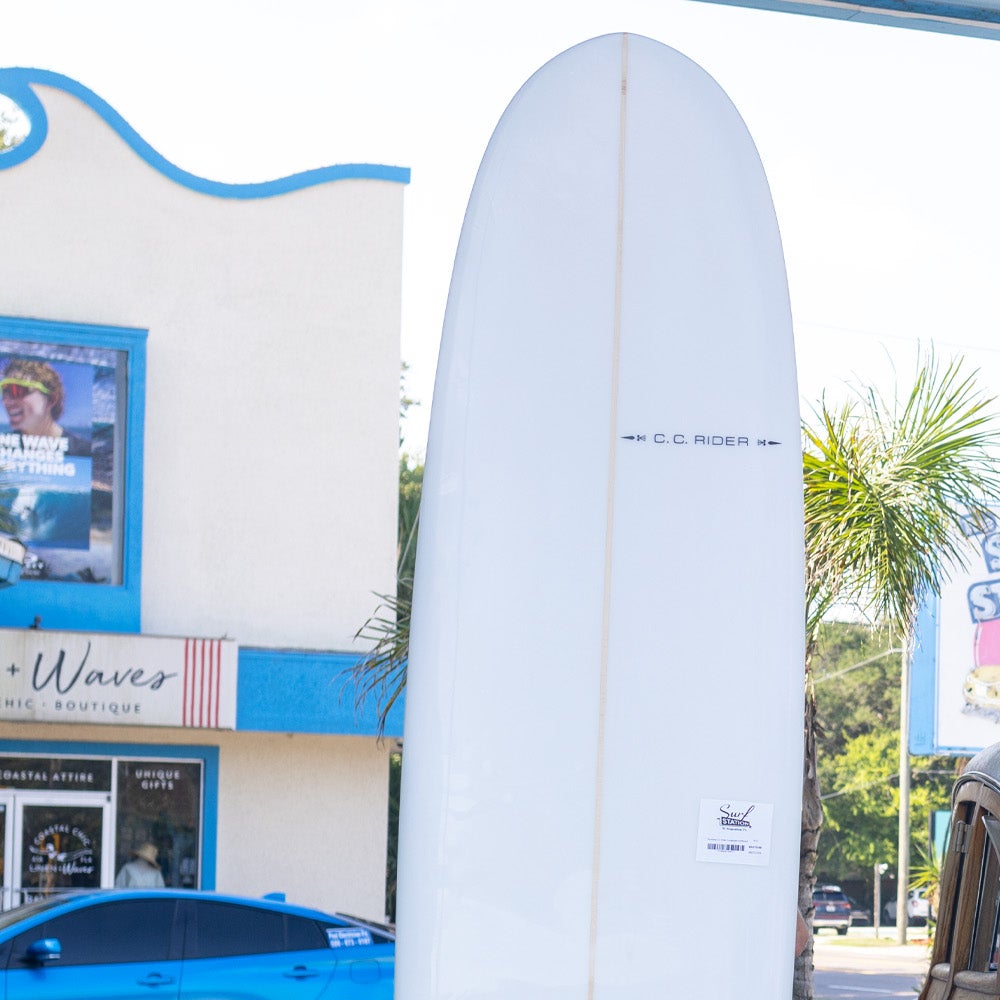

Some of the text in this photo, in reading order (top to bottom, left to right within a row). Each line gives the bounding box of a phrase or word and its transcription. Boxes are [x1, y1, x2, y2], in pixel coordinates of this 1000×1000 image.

[22, 434, 69, 452] WAVE
[694, 435, 749, 446] RIDER
[32, 640, 178, 695] Waves
[0, 699, 141, 715] HIC BOUTIQUE
[53, 772, 94, 783] ATTIRE
[135, 769, 181, 780] UNIQUE
[141, 780, 174, 791] GIFTS
[719, 803, 755, 821] Surf
